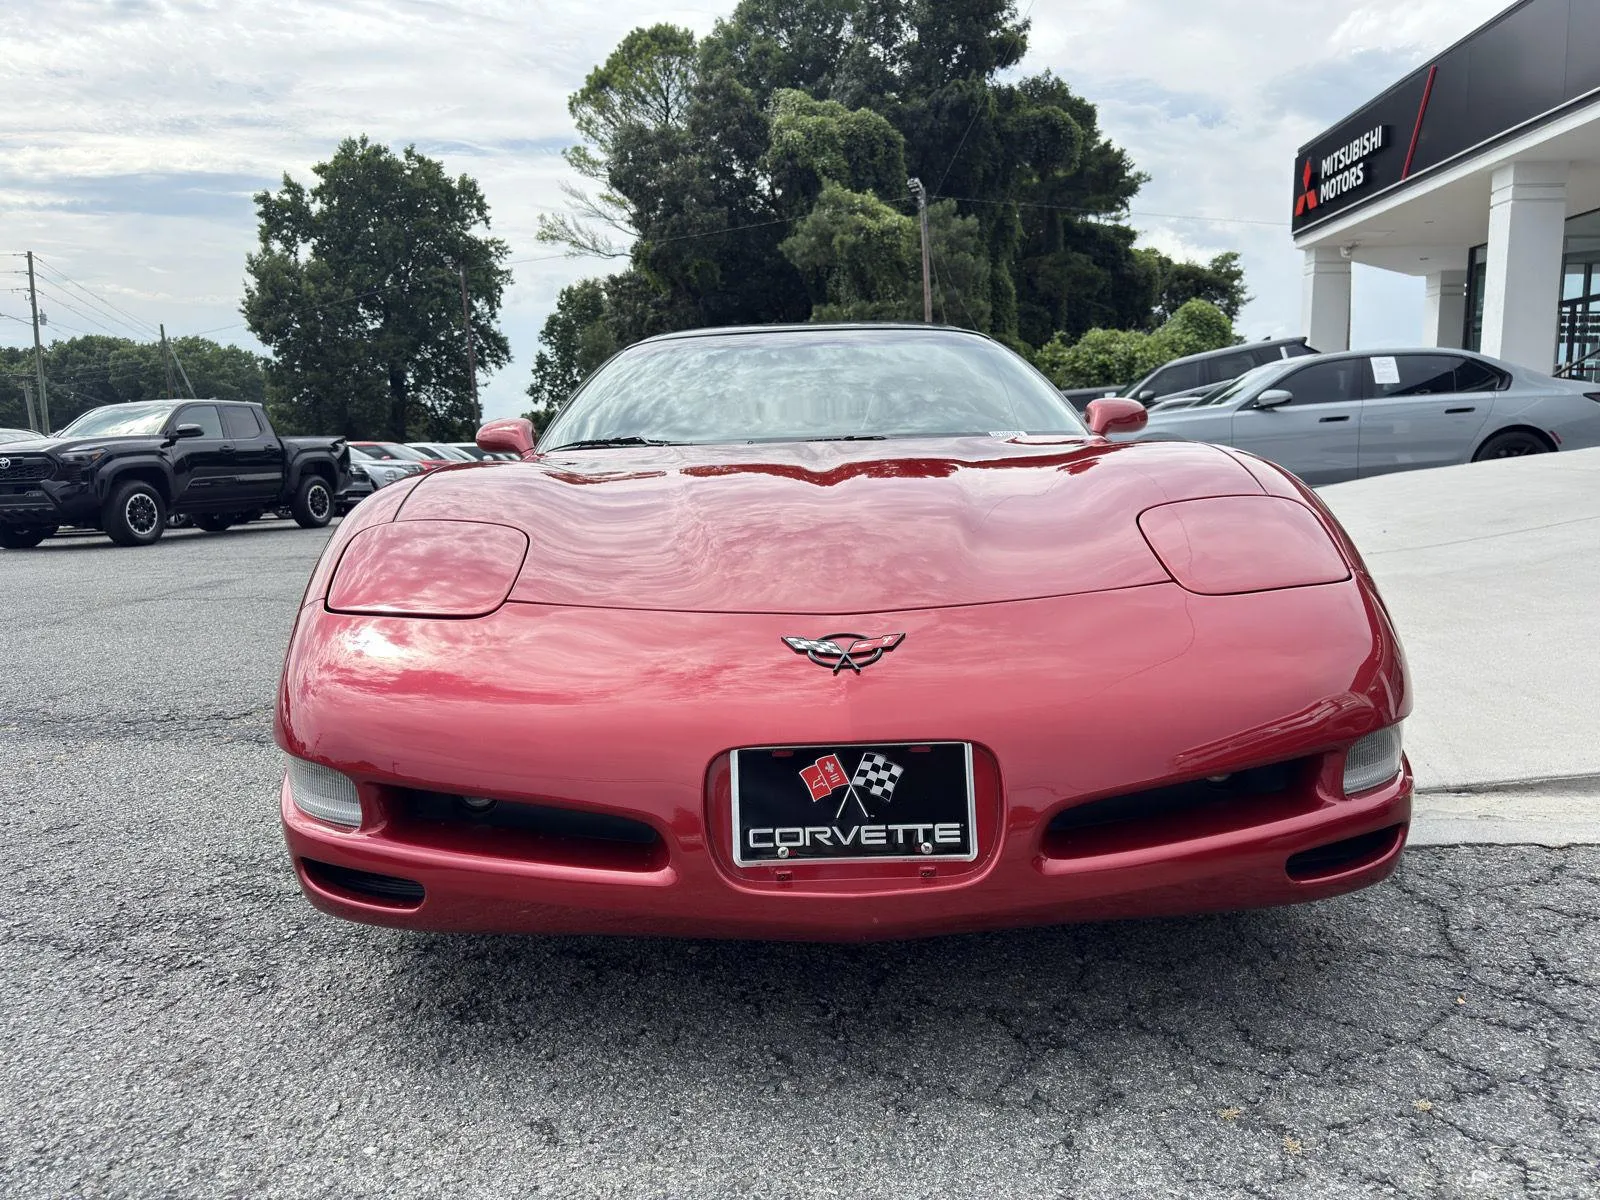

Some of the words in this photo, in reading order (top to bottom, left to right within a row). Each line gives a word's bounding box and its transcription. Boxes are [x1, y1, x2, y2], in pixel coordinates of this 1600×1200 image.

[1321, 125, 1382, 179] MITSUBISHI
[1320, 162, 1364, 203] MOTORS
[749, 823, 962, 848] CORVETTE
